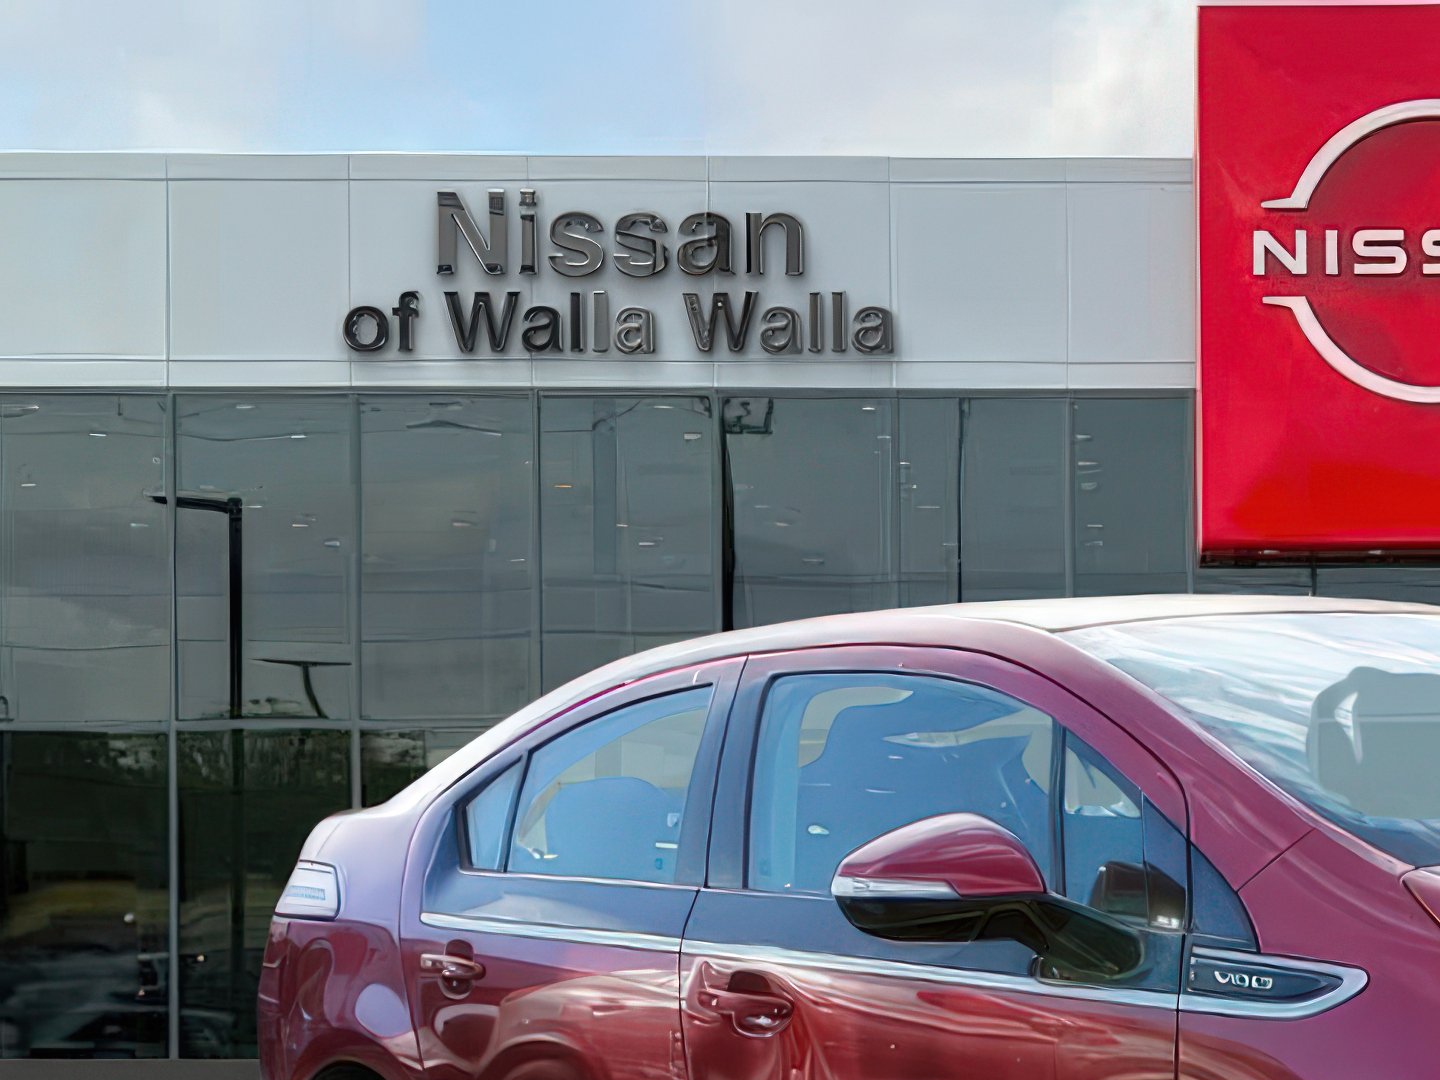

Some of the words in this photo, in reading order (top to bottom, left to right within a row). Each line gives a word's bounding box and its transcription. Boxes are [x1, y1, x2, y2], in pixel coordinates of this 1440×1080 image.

[436, 188, 805, 278] Nissan
[342, 290, 420, 353] of
[445, 290, 656, 355] Walla
[683, 290, 895, 355] Walla
